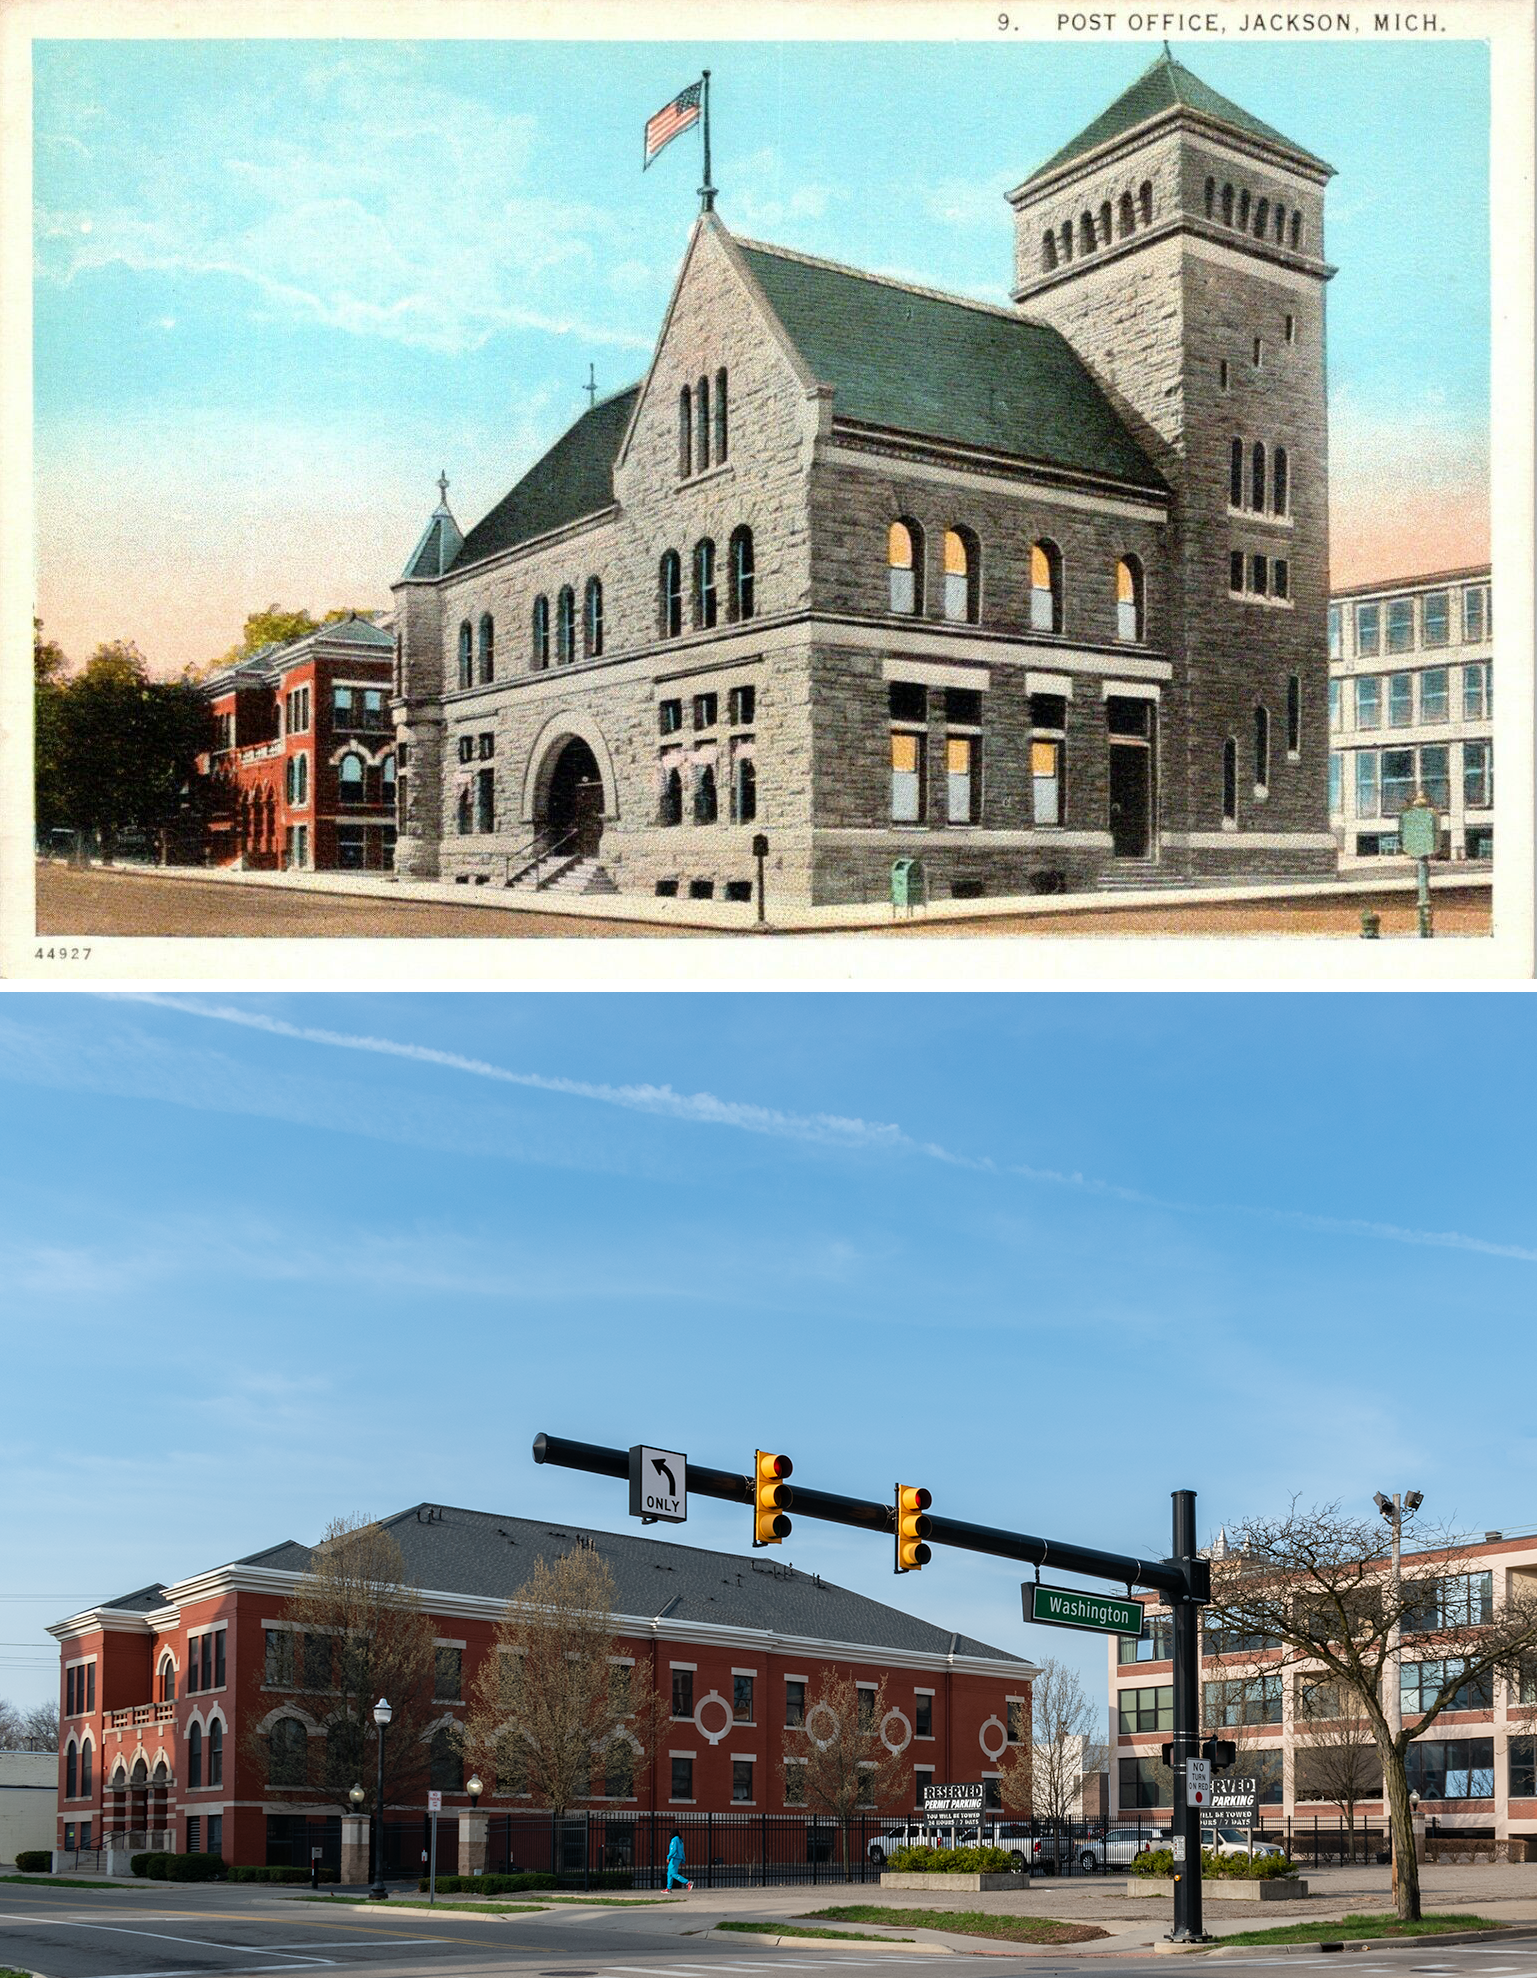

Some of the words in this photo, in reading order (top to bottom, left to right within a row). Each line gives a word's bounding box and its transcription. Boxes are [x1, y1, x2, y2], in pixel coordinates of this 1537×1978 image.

[646, 1495, 680, 1513] ONLY
[1049, 1596, 1129, 1625] Washington
[1192, 1762, 1205, 1772] NO
[1192, 1773, 1206, 1781] TURN
[1198, 1782, 1208, 1790] RED
[924, 1785, 983, 1798] RESERVED
[925, 1800, 951, 1809] PERMIT
[950, 1799, 982, 1809] PARKING
[1211, 1795, 1254, 1806] PARKING
[1231, 1818, 1251, 1826] DAYS
